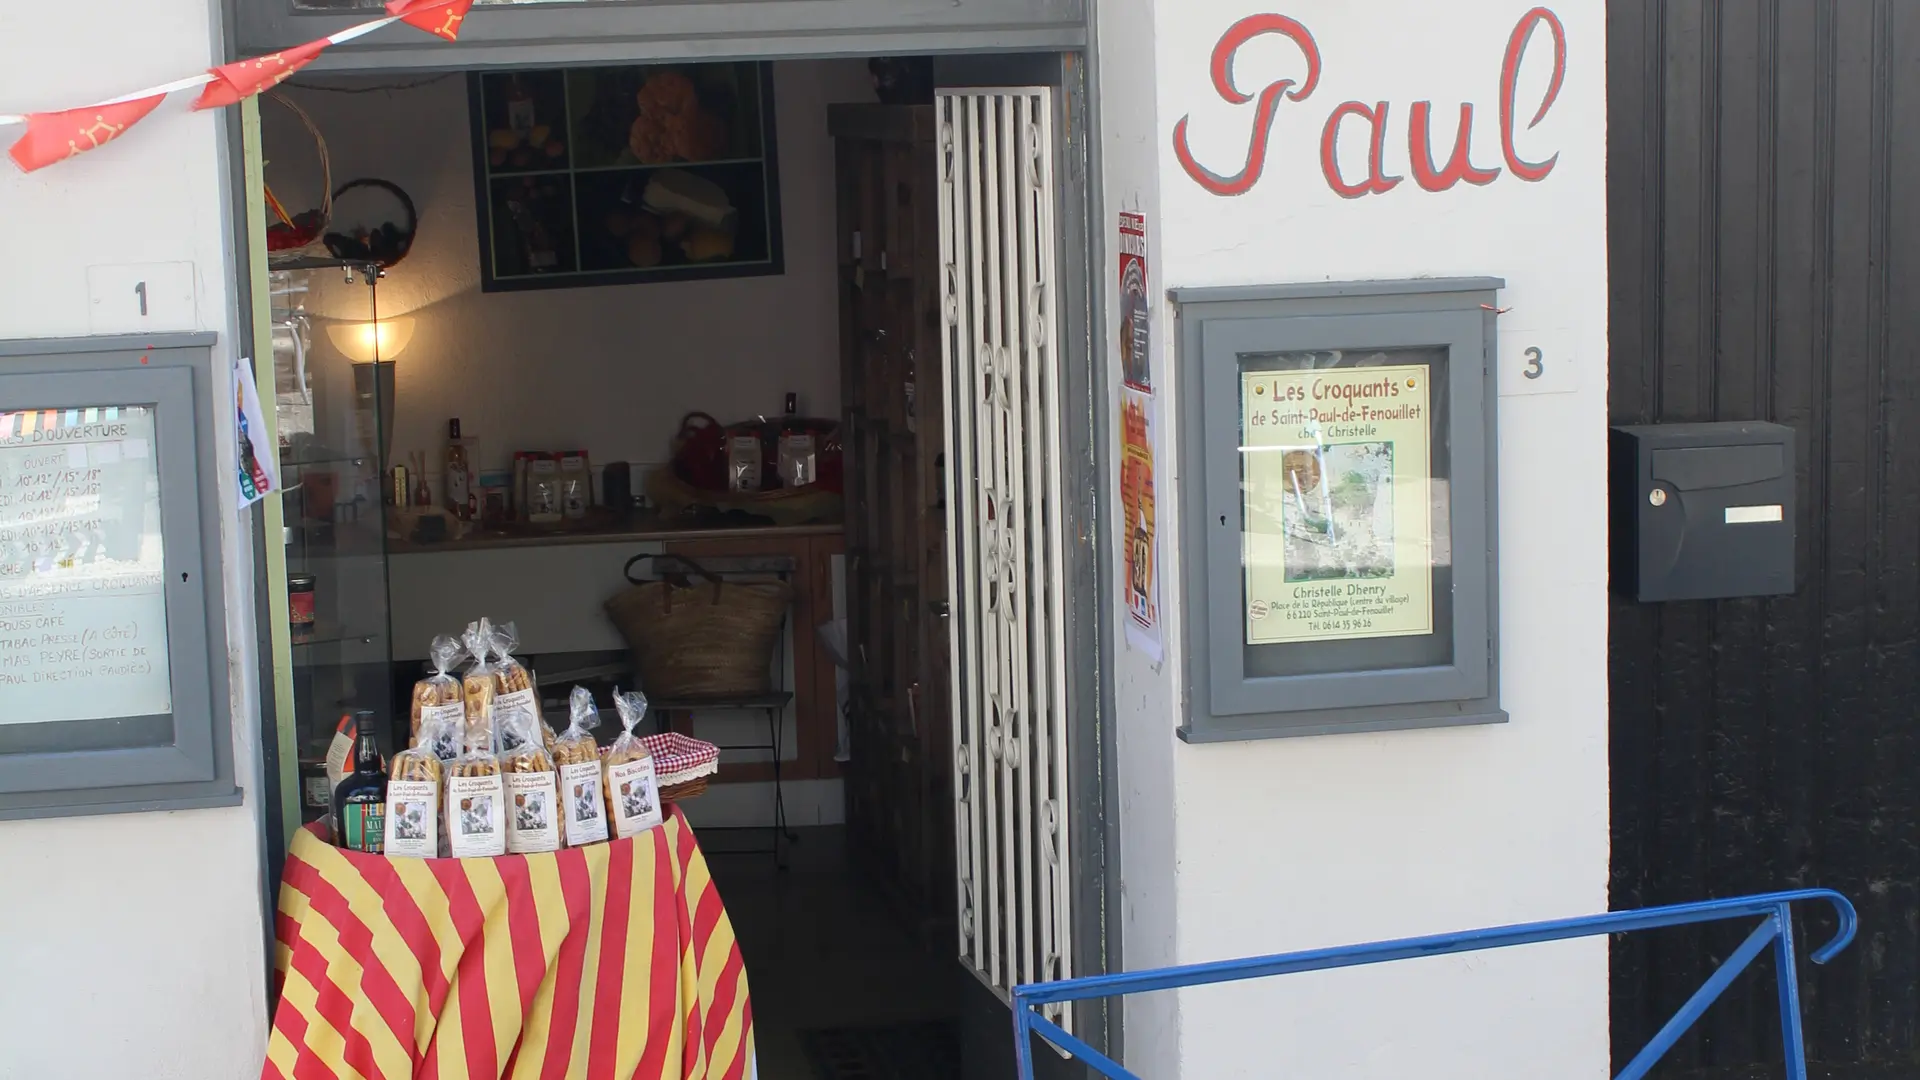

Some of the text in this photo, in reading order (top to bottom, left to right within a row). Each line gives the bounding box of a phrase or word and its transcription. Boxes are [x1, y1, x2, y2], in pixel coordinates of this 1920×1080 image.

[1173, 7, 1566, 199] Paul
[135, 281, 147, 316] 1
[1523, 346, 1544, 379] 3
[1273, 377, 1399, 408] Les Croquants
[1251, 403, 1421, 427] de Saint-Paul-de-Fenouillet
[1328, 424, 1377, 439] Christelle
[24, 453, 64, 470] OUVERT
[1293, 583, 1386, 599] Christelle Dhenry
[1271, 600, 1290, 611] Place
[1292, 600, 1301, 609] de
[1303, 599, 1310, 608] la
[1312, 597, 1348, 610] République
[1375, 596, 1384, 605] du
[1313, 604, 1394, 619] Saint-Paul-de-Fenouillet
[35, 610, 65, 628] CAFÉ
[0, 637, 36, 649] TABAC
[133, 646, 147, 657] DE
